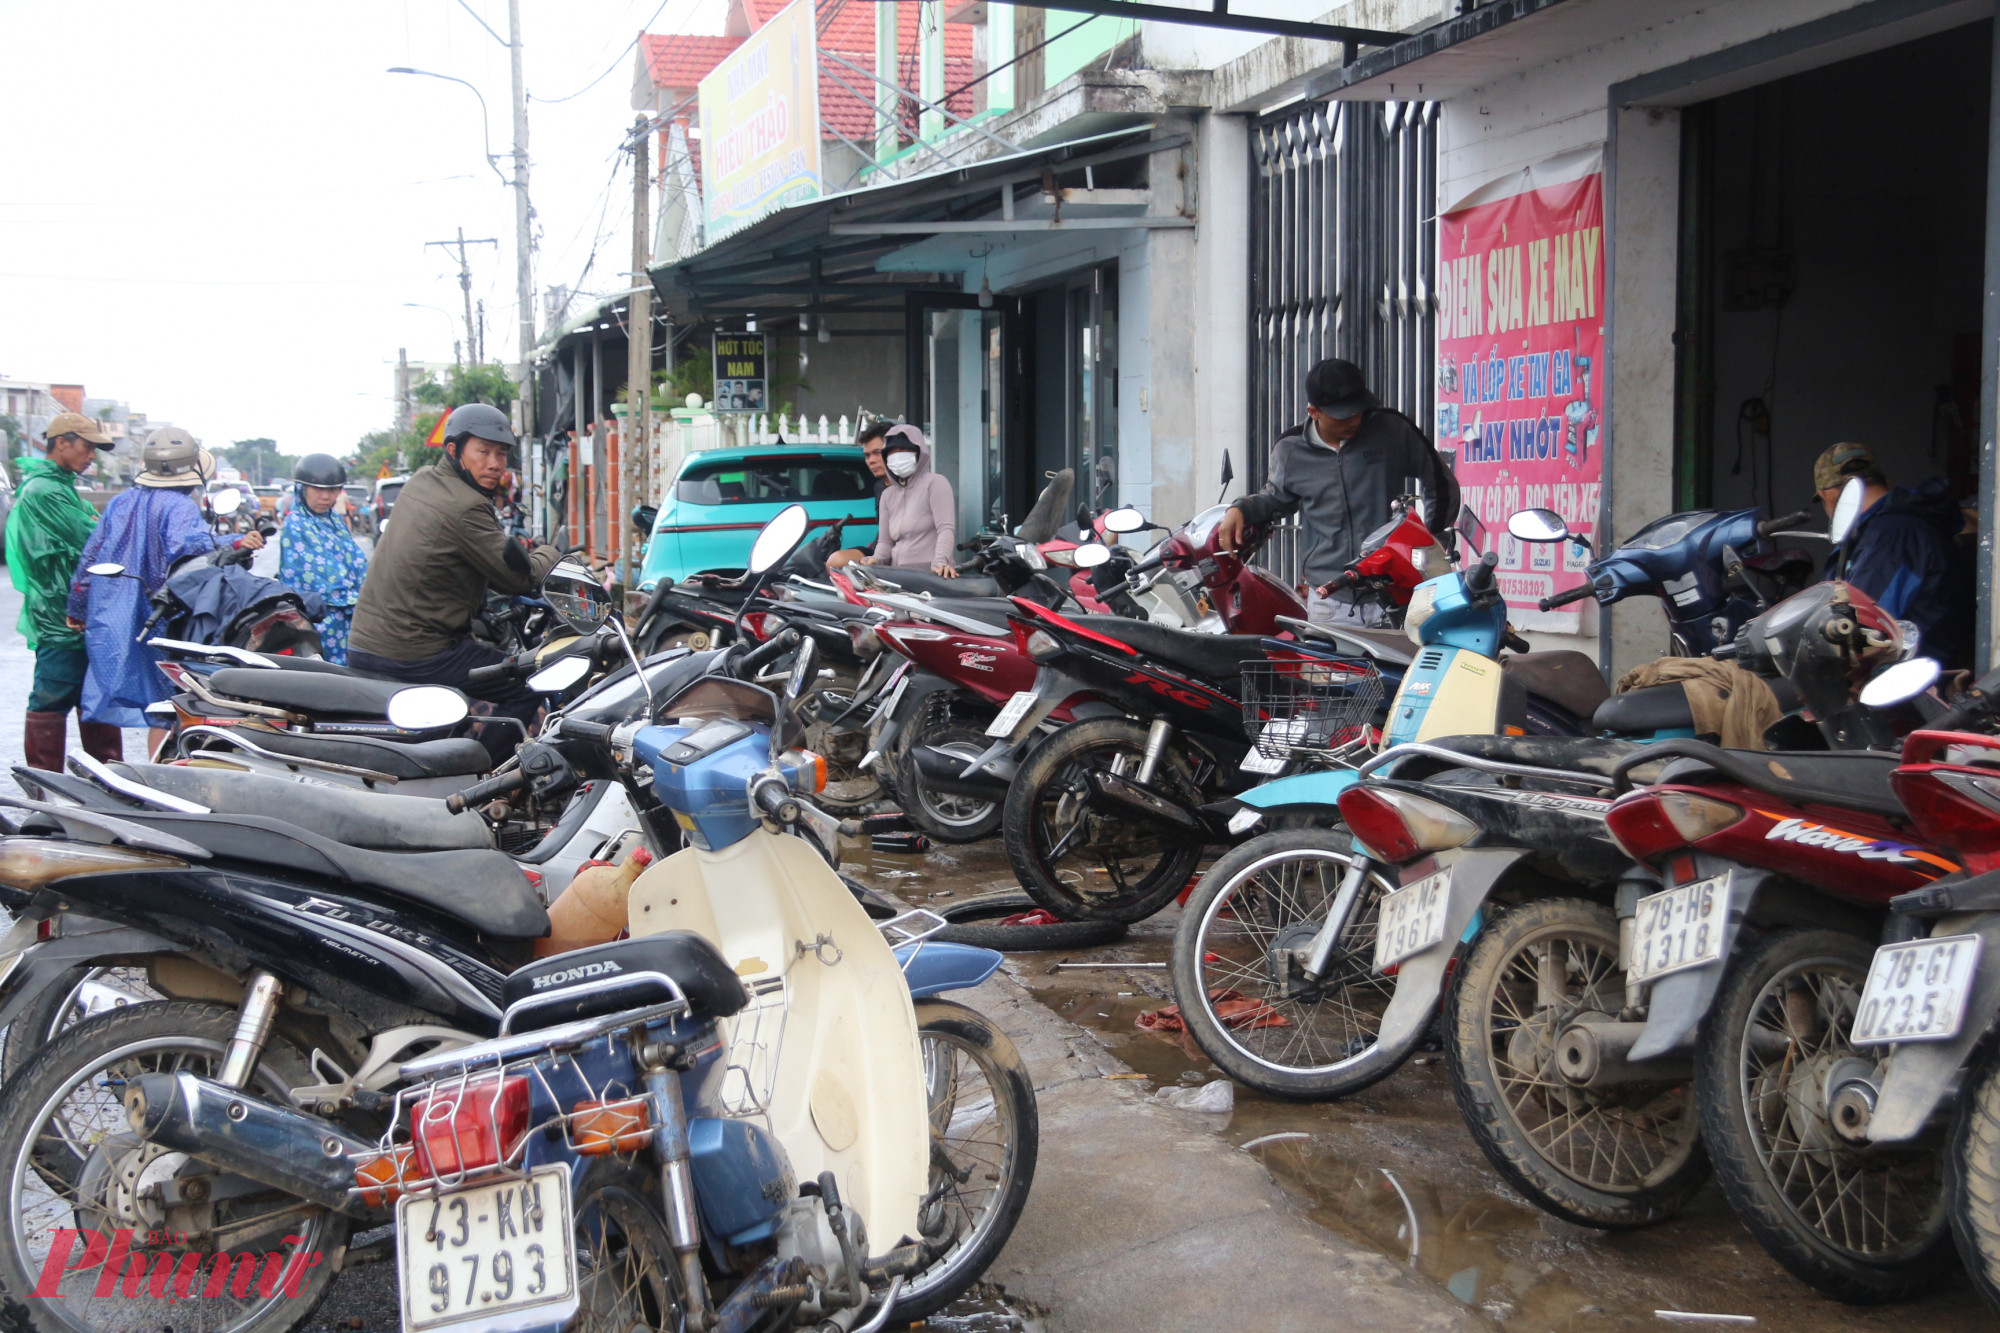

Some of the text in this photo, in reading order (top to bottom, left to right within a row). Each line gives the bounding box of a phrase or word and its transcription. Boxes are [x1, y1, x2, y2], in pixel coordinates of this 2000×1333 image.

[1440, 224, 1483, 341] ĐIỂM
[1527, 238, 1549, 327] XE
[1553, 210, 1600, 324] MÁY
[727, 361, 755, 377] NAM
[1462, 344, 1572, 405] VÁ LỐP XE TAY GA
[1509, 407, 1562, 462] NHỚT
[1383, 911, 1433, 964] 7961
[1641, 923, 1710, 974] 1318
[532, 959, 622, 989] HONDA
